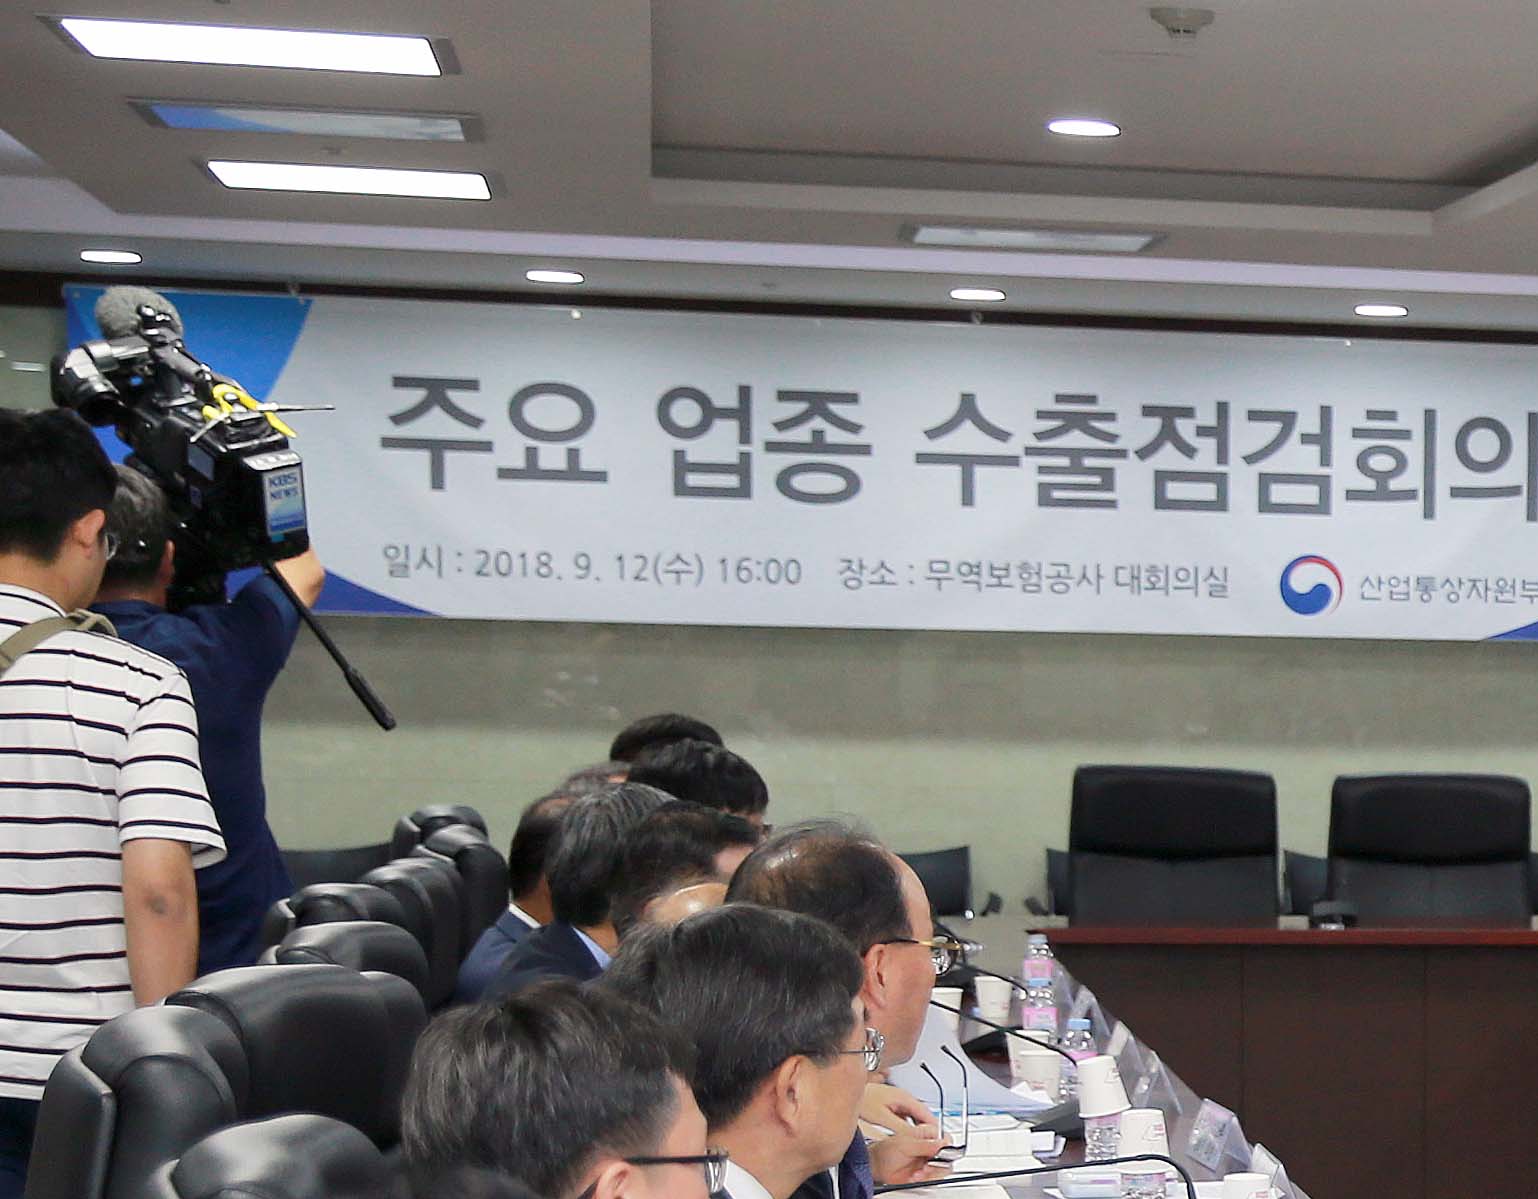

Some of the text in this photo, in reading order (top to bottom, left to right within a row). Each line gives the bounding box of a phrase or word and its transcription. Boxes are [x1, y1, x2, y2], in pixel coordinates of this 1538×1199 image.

[380, 376, 608, 491] 주요
[656, 385, 872, 505] 업종
[382, 543, 444, 579] 일시
[474, 548, 564, 581] 2018.
[615, 552, 705, 586] 12(수)
[719, 556, 802, 586] 16:00
[838, 557, 899, 591] 장소
[923, 559, 1105, 596] 무역보험공사
[1113, 563, 1230, 599] 대회의실
